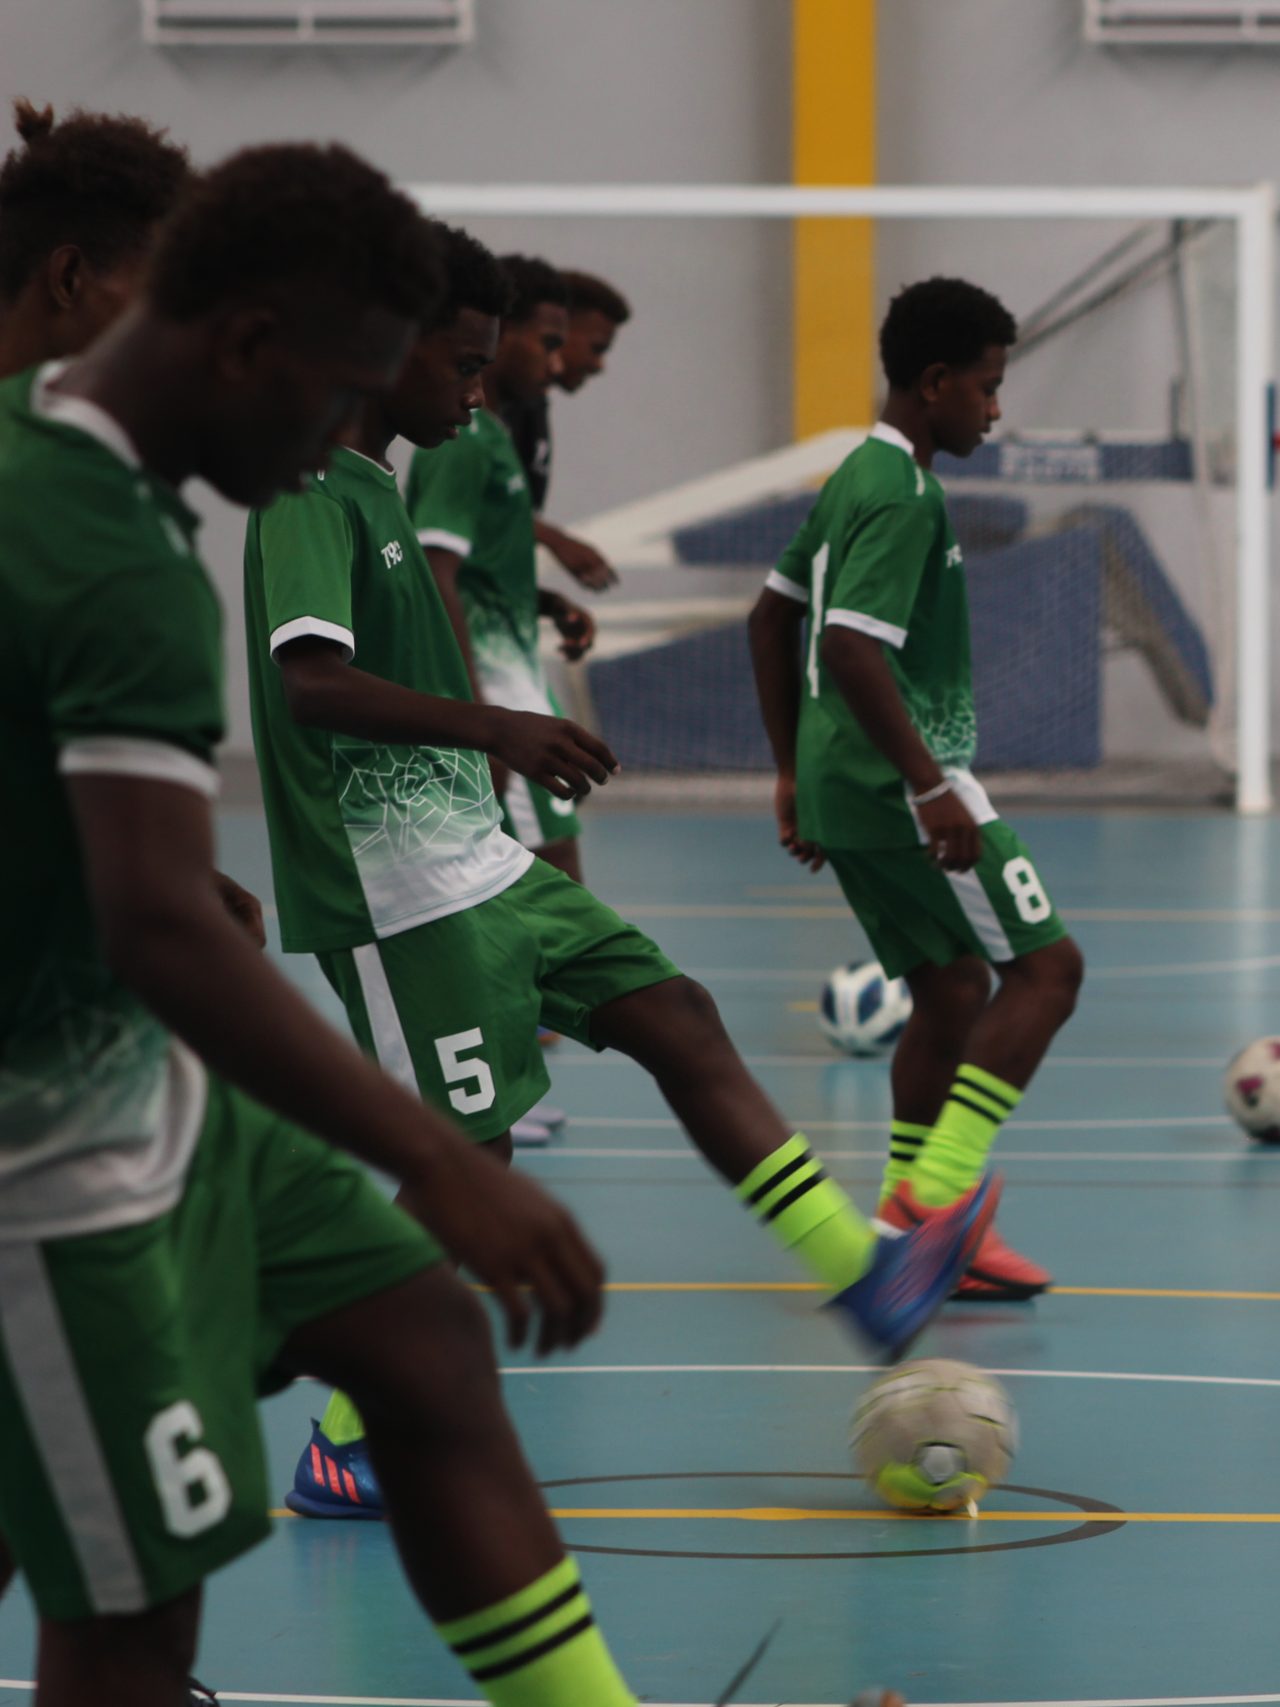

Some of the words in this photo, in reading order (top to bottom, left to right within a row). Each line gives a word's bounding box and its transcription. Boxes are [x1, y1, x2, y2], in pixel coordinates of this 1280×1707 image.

[1002, 855, 1052, 924] 8
[434, 1026, 496, 1115] 5
[144, 1399, 233, 1538] 6
